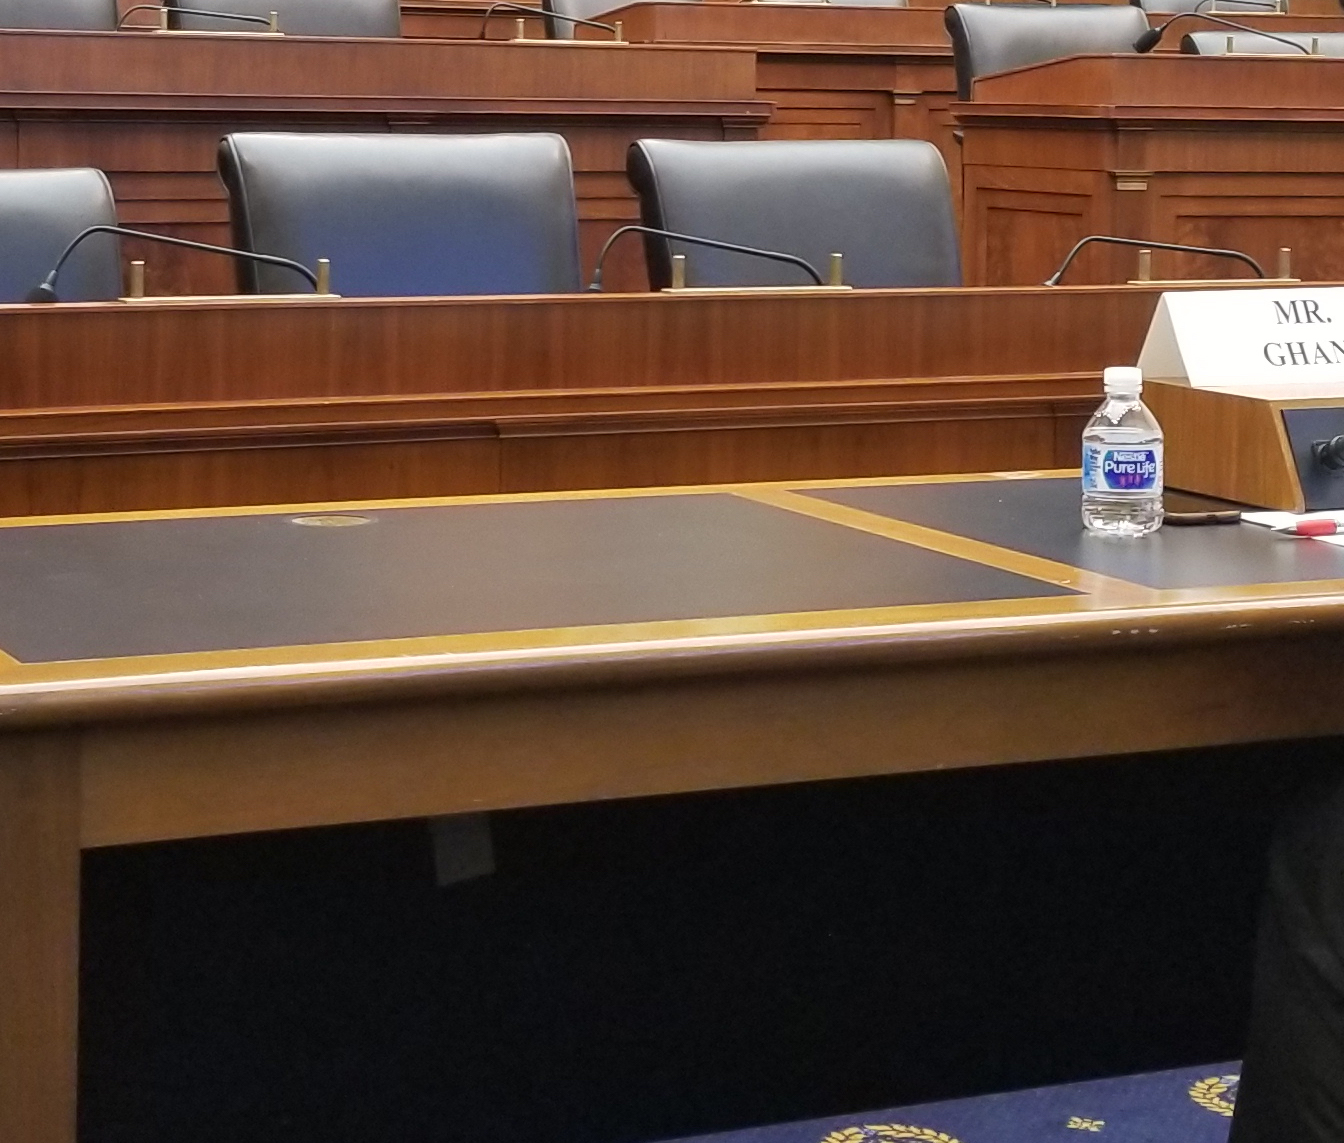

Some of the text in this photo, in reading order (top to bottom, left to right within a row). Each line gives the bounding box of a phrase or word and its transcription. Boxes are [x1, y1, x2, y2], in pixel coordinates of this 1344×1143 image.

[1271, 299, 1332, 325] MR.
[1104, 460, 1135, 474] Pure
[1136, 460, 1156, 479] Life
